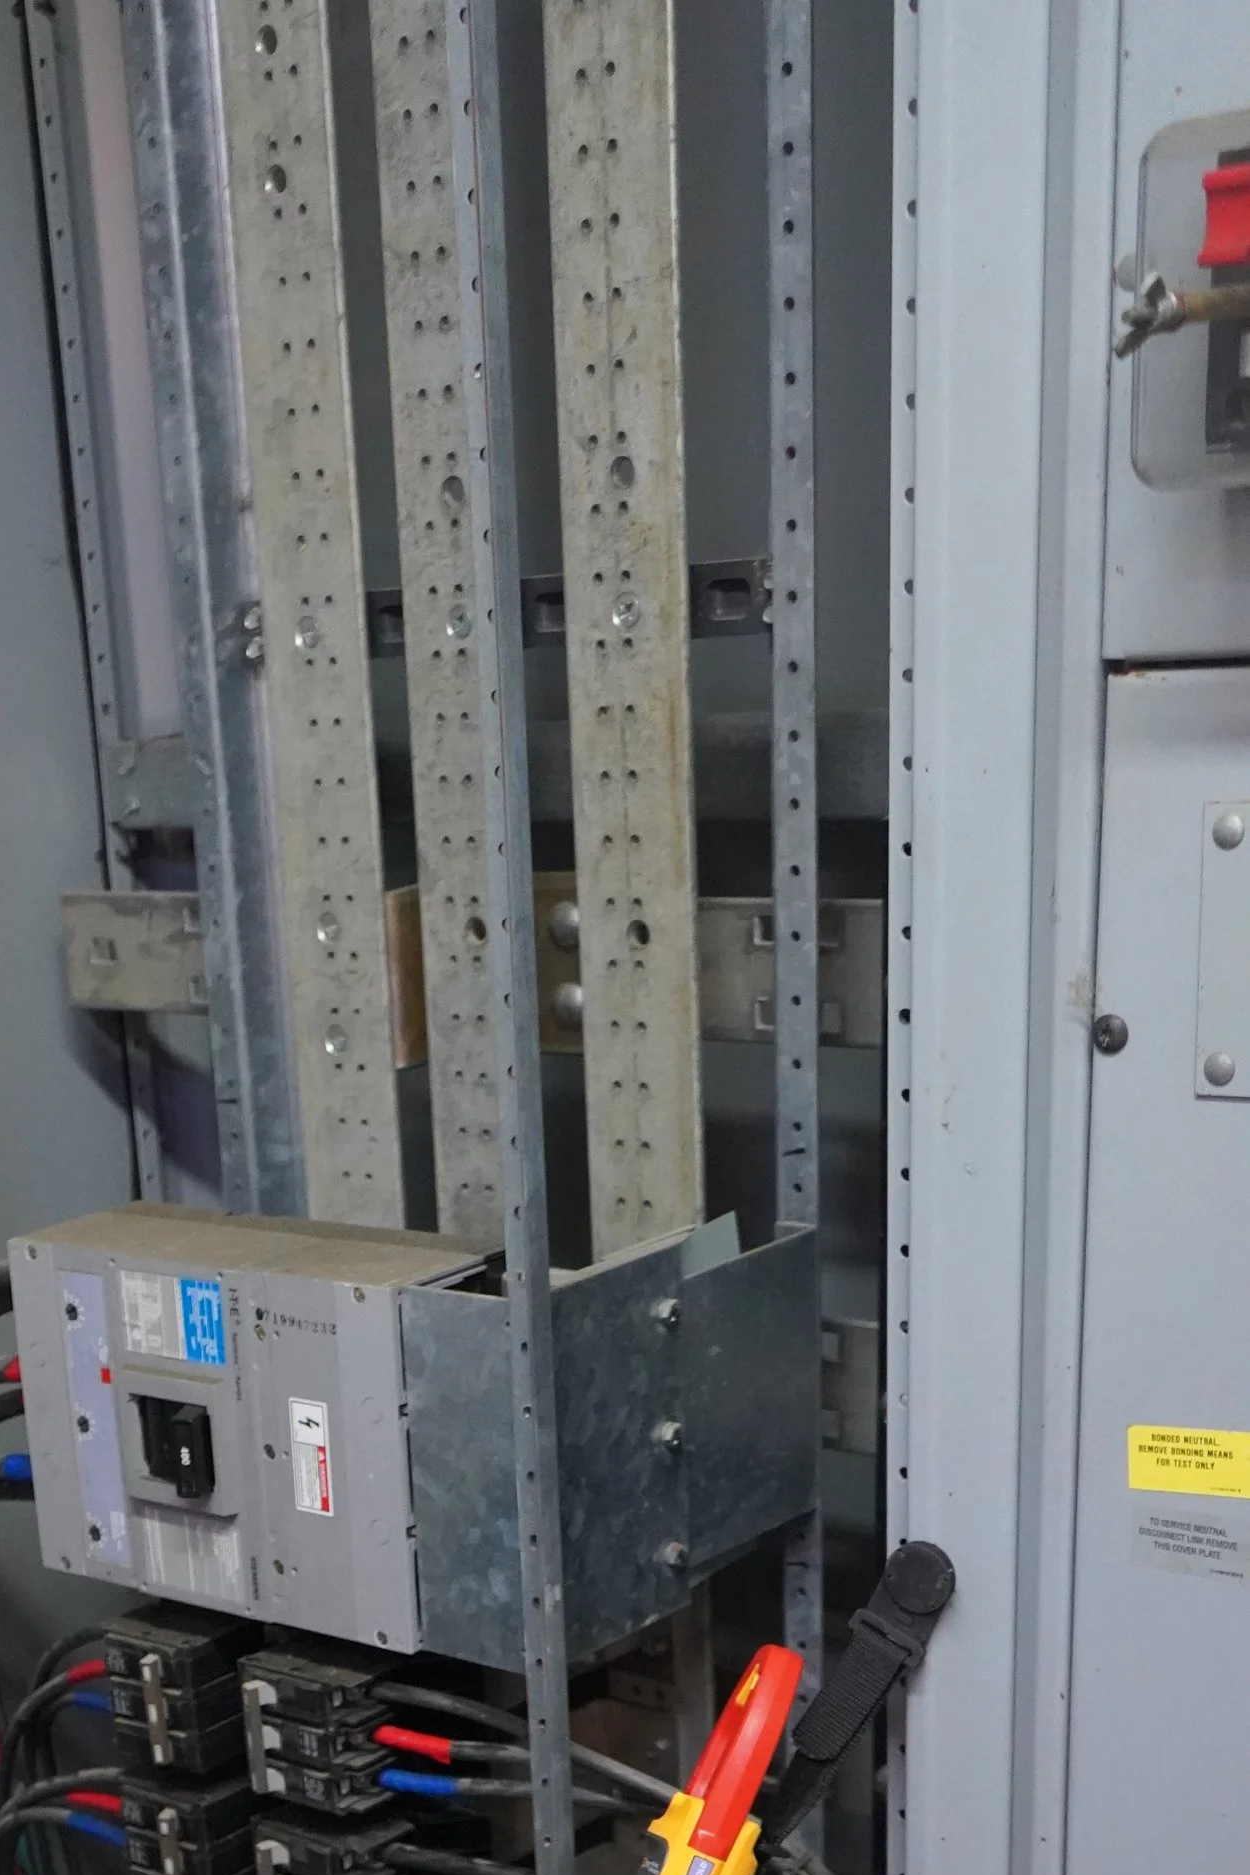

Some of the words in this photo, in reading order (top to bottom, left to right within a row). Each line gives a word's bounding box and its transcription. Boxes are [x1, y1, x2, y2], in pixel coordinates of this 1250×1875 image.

[1151, 1434, 1180, 1444] BONDED
[1138, 1445, 1168, 1455] REMOVE
[1171, 1447, 1204, 1458] BONDING
[1207, 1450, 1234, 1460] MEANS
[1156, 1458, 1171, 1466] FOR
[1174, 1459, 1192, 1468] TEST
[1195, 1461, 1216, 1470] ONLY
[1199, 1549, 1222, 1560] PLATE
